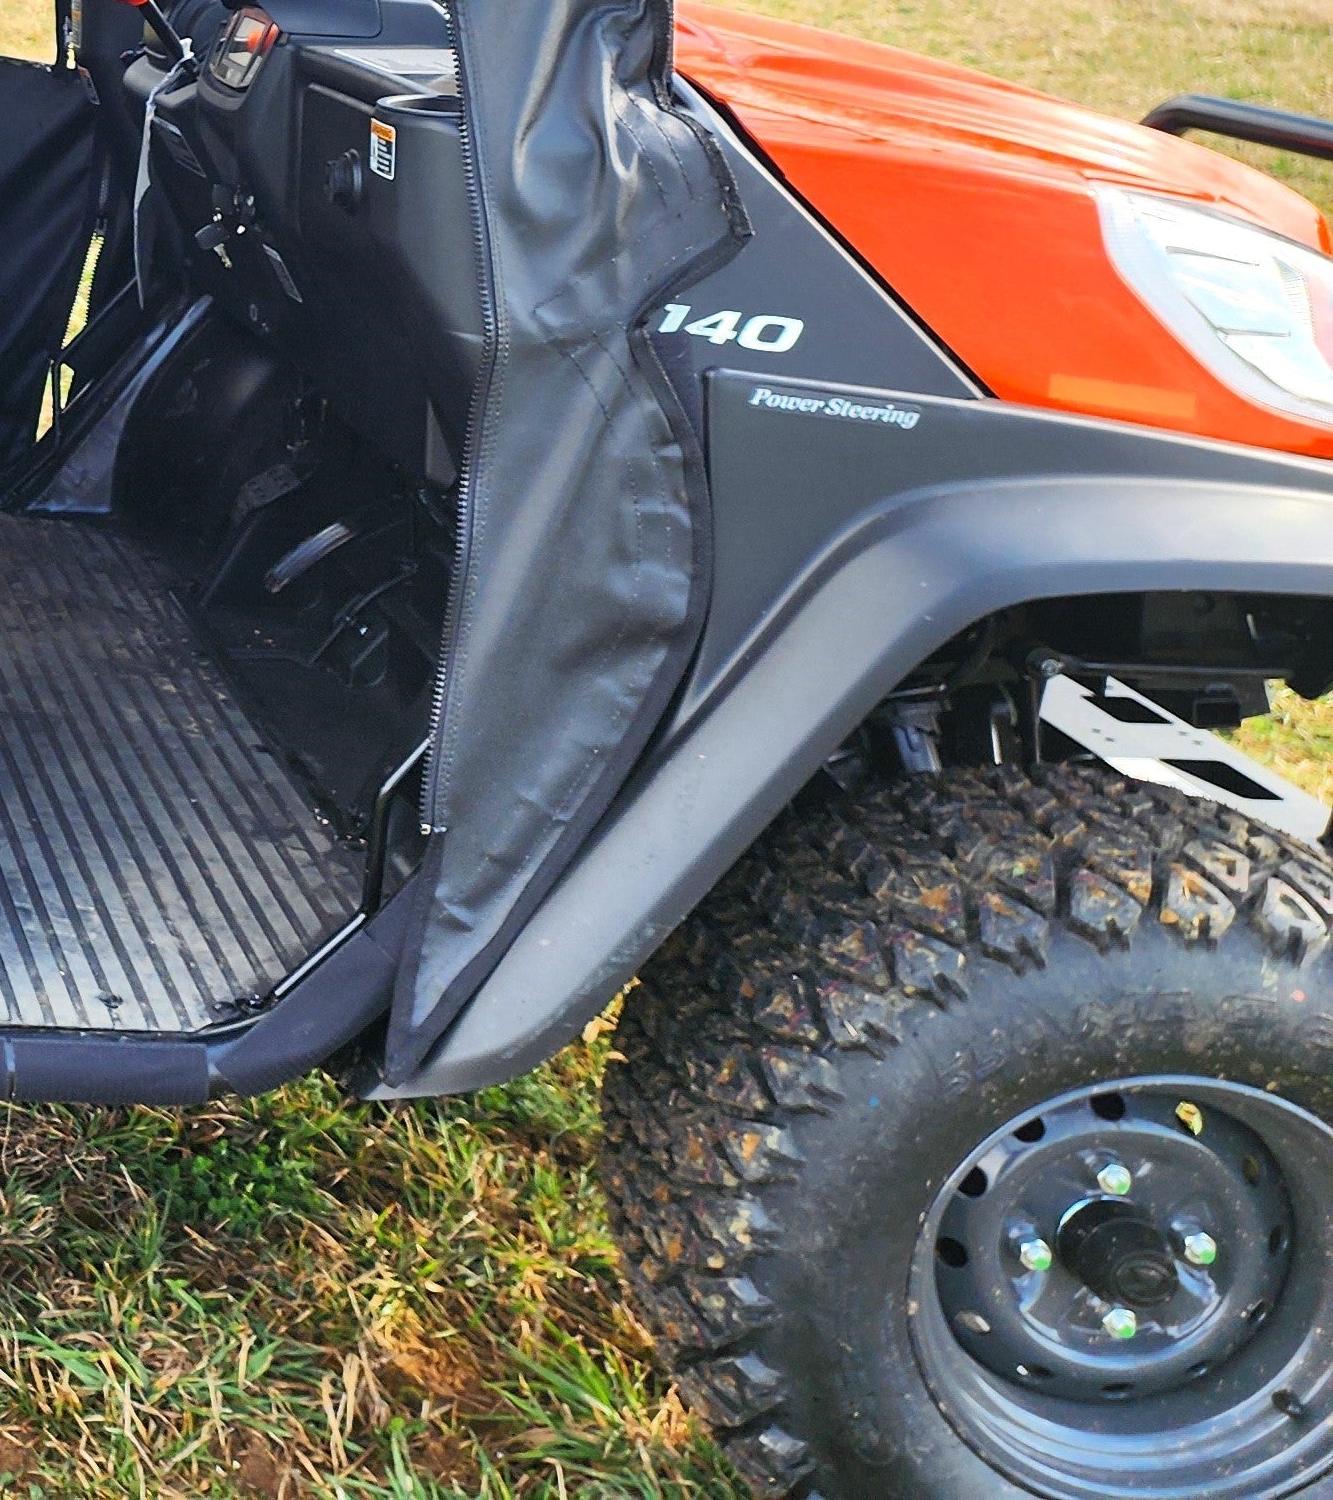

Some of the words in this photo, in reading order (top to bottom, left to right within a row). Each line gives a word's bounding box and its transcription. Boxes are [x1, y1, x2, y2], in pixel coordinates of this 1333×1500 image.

[658, 303, 804, 352] 140
[748, 387, 826, 414] Power
[823, 397, 921, 430] Steering
